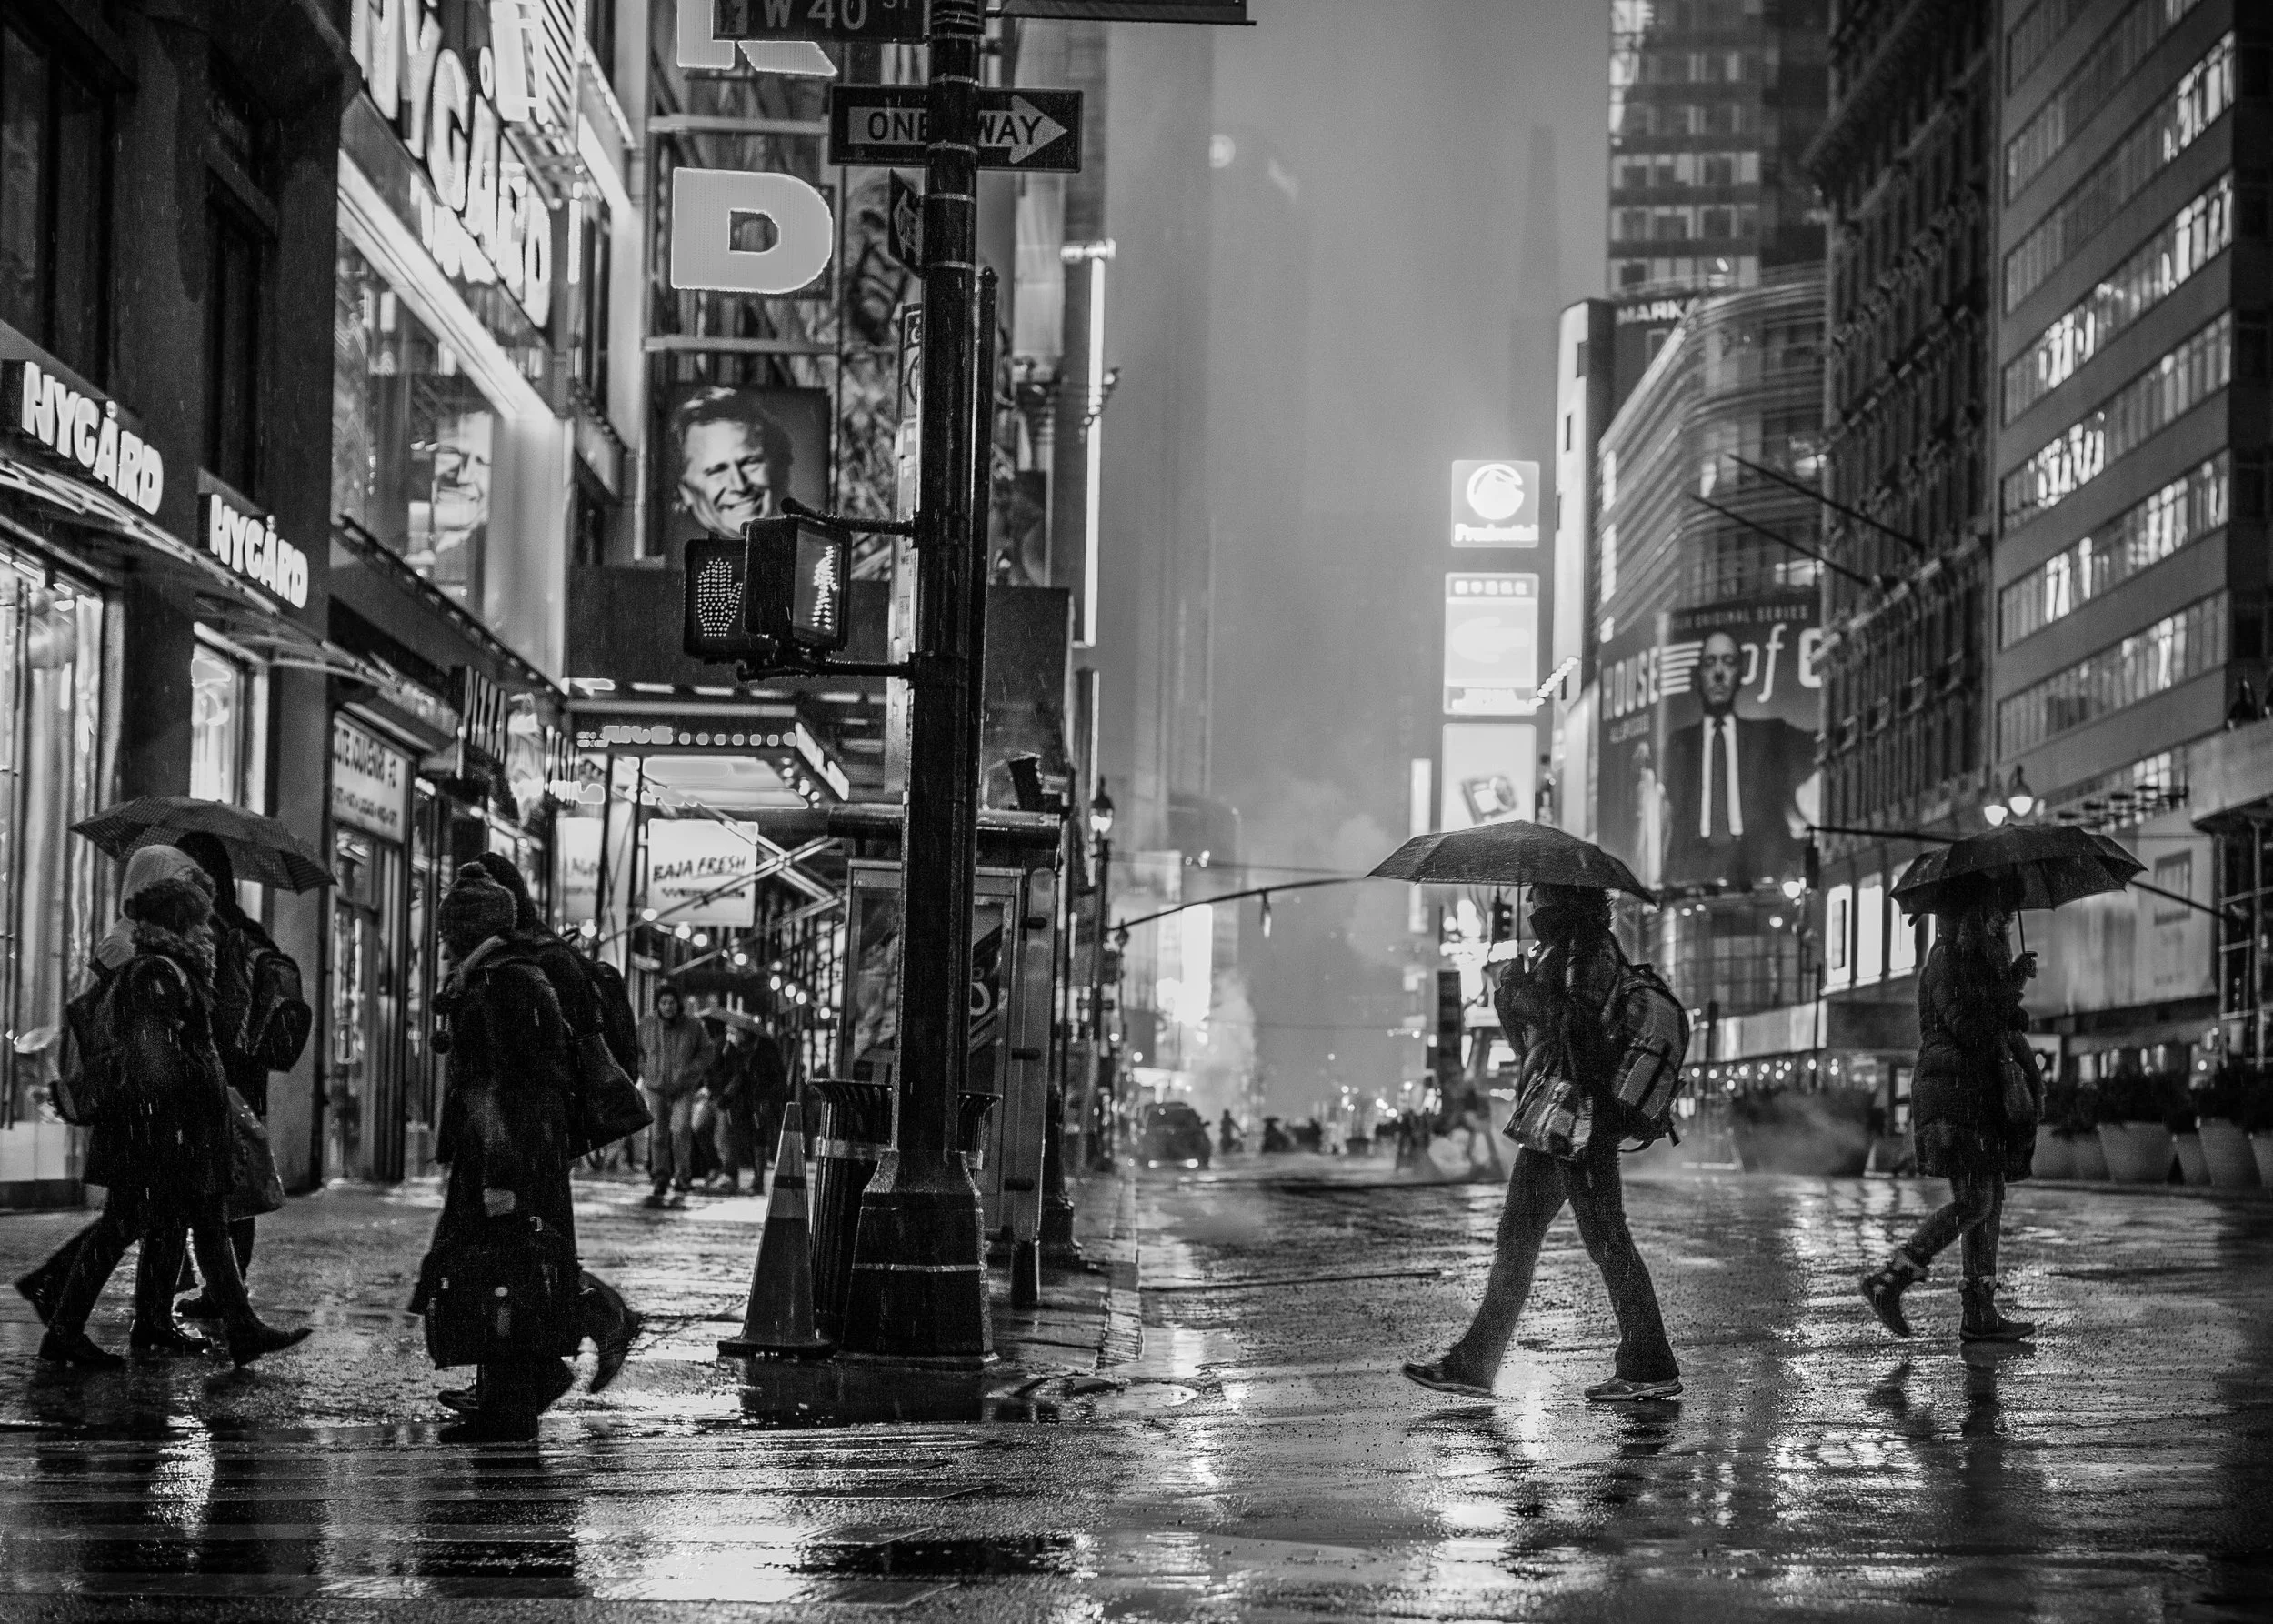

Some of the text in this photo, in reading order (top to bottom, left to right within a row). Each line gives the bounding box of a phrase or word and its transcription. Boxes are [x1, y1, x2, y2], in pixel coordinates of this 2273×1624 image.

[763, 0, 795, 28] W
[807, 0, 867, 30] 40
[867, 111, 928, 141] ONE
[22, 361, 164, 516] NYGÅRD
[210, 494, 309, 609] NYGÅRD
[653, 855, 746, 883] BAJA FRESH
